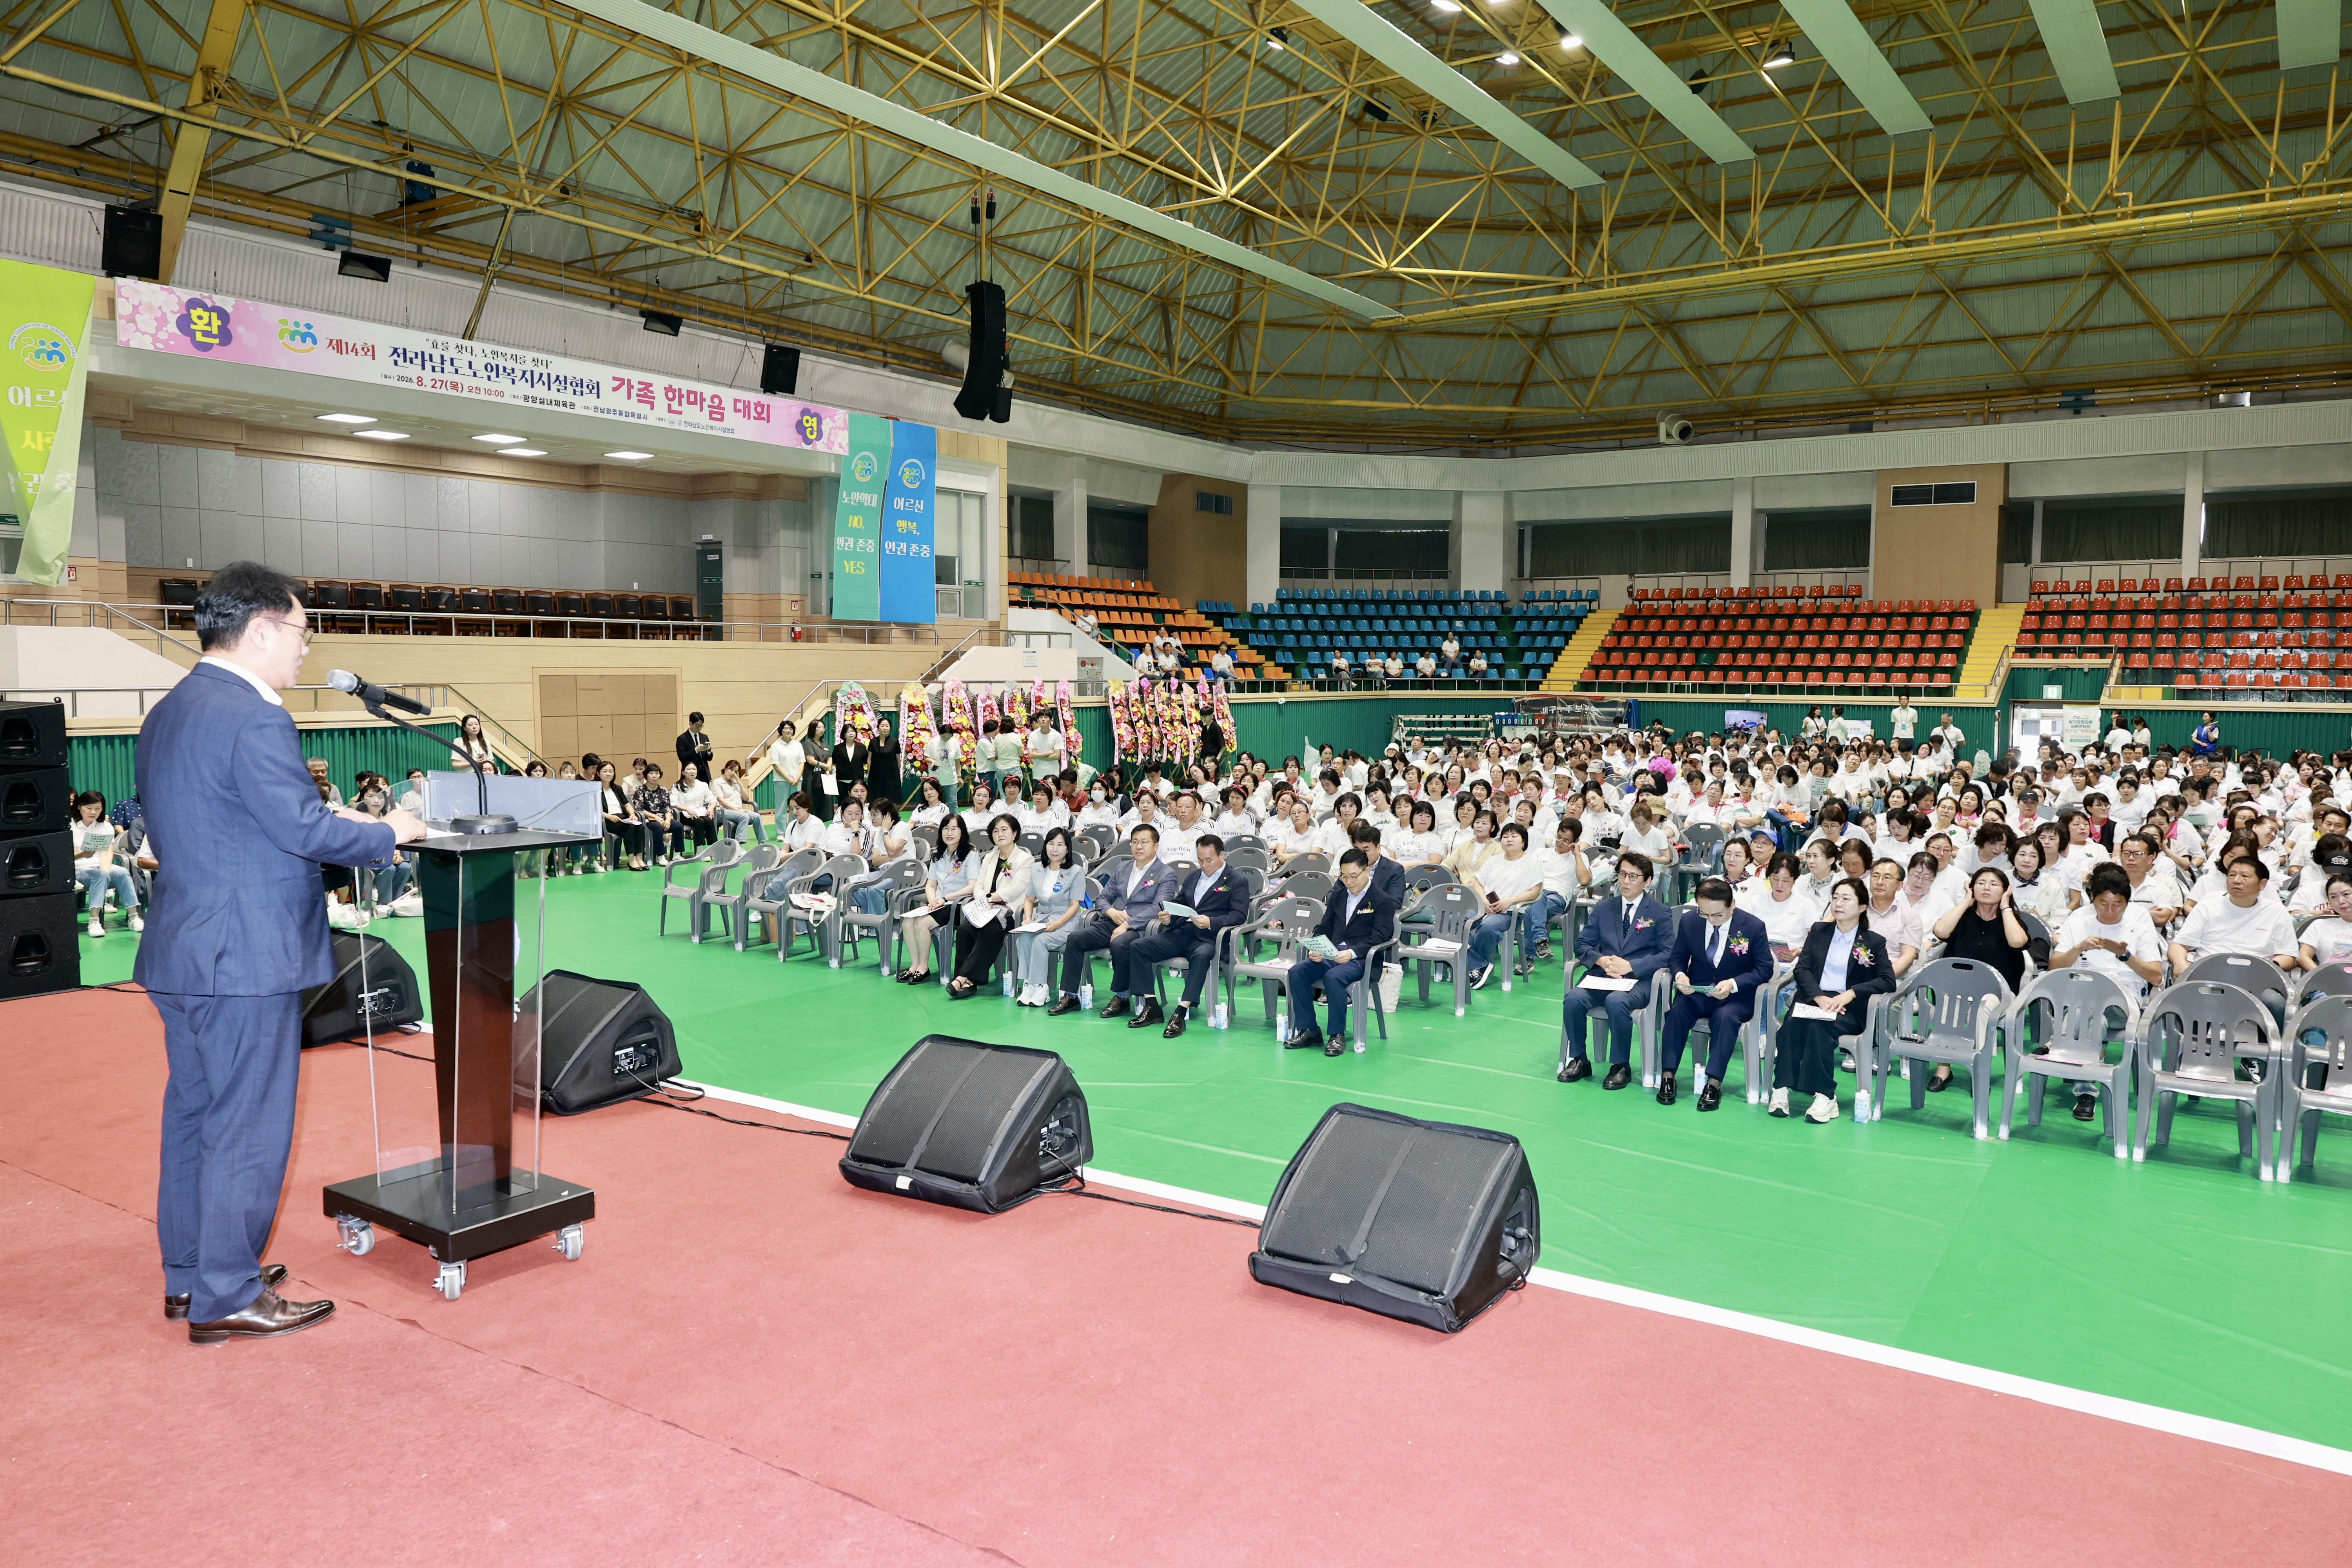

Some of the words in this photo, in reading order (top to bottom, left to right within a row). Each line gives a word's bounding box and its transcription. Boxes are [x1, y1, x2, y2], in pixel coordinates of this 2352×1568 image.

[15, 323, 41, 336] FEDERATION
[50, 325, 66, 338] SENIOR
[189, 308, 222, 344] 환
[326, 338, 376, 361] 제14회
[482, 348, 527, 365] 노인복지를
[388, 346, 600, 399] 전라남도노인복지시설협회
[396, 375, 415, 384] 2026.
[416, 376, 427, 387] 8.
[430, 378, 464, 393] 27(목)
[467, 385, 481, 394] 오전
[483, 387, 505, 398] 10:00
[523, 394, 575, 410] 광양실내체육관
[612, 376, 655, 411] 가족
[664, 384, 725, 422] 한마음
[733, 397, 771, 423] 대회
[593, 406, 648, 421] 전남광주통합특별시
[683, 420, 735, 434] 전라남도노인복지시설협회
[802, 415, 818, 440] 영
[842, 490, 878, 507] 노인학대
[893, 497, 924, 513] 어르신
[896, 519, 920, 536] 행복,
[837, 536, 854, 551] 인권
[856, 538, 875, 552] 존중
[884, 541, 907, 555] 인권
[909, 543, 931, 557] 존중
[843, 560, 865, 574] YES
